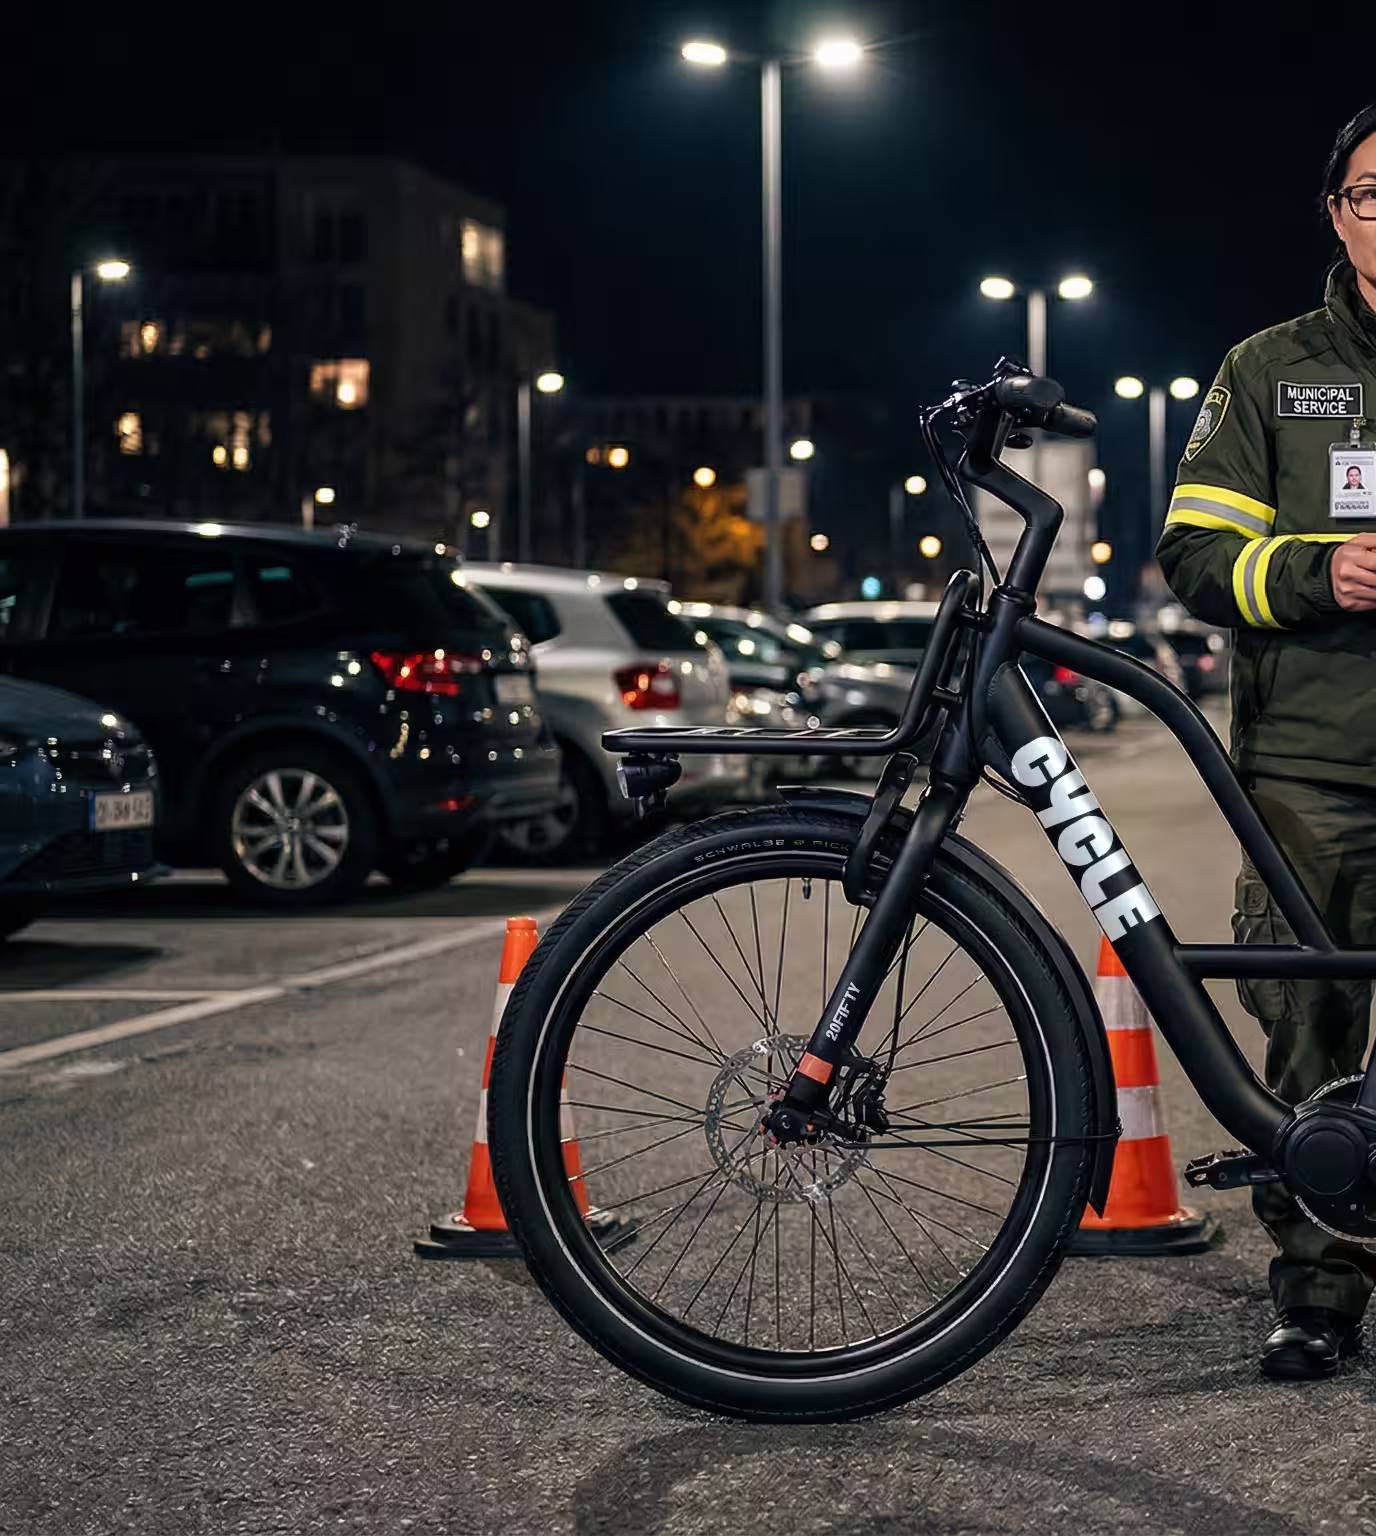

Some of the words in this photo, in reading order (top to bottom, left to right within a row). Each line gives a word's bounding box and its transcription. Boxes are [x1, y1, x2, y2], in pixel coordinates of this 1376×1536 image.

[1287, 386, 1354, 401] MUNICIPAL
[1293, 400, 1347, 414] SERVICE
[694, 839, 785, 862] SCHWALBE
[1011, 736, 1161, 943] CYCLE
[825, 981, 860, 1042] 20FIFTY
